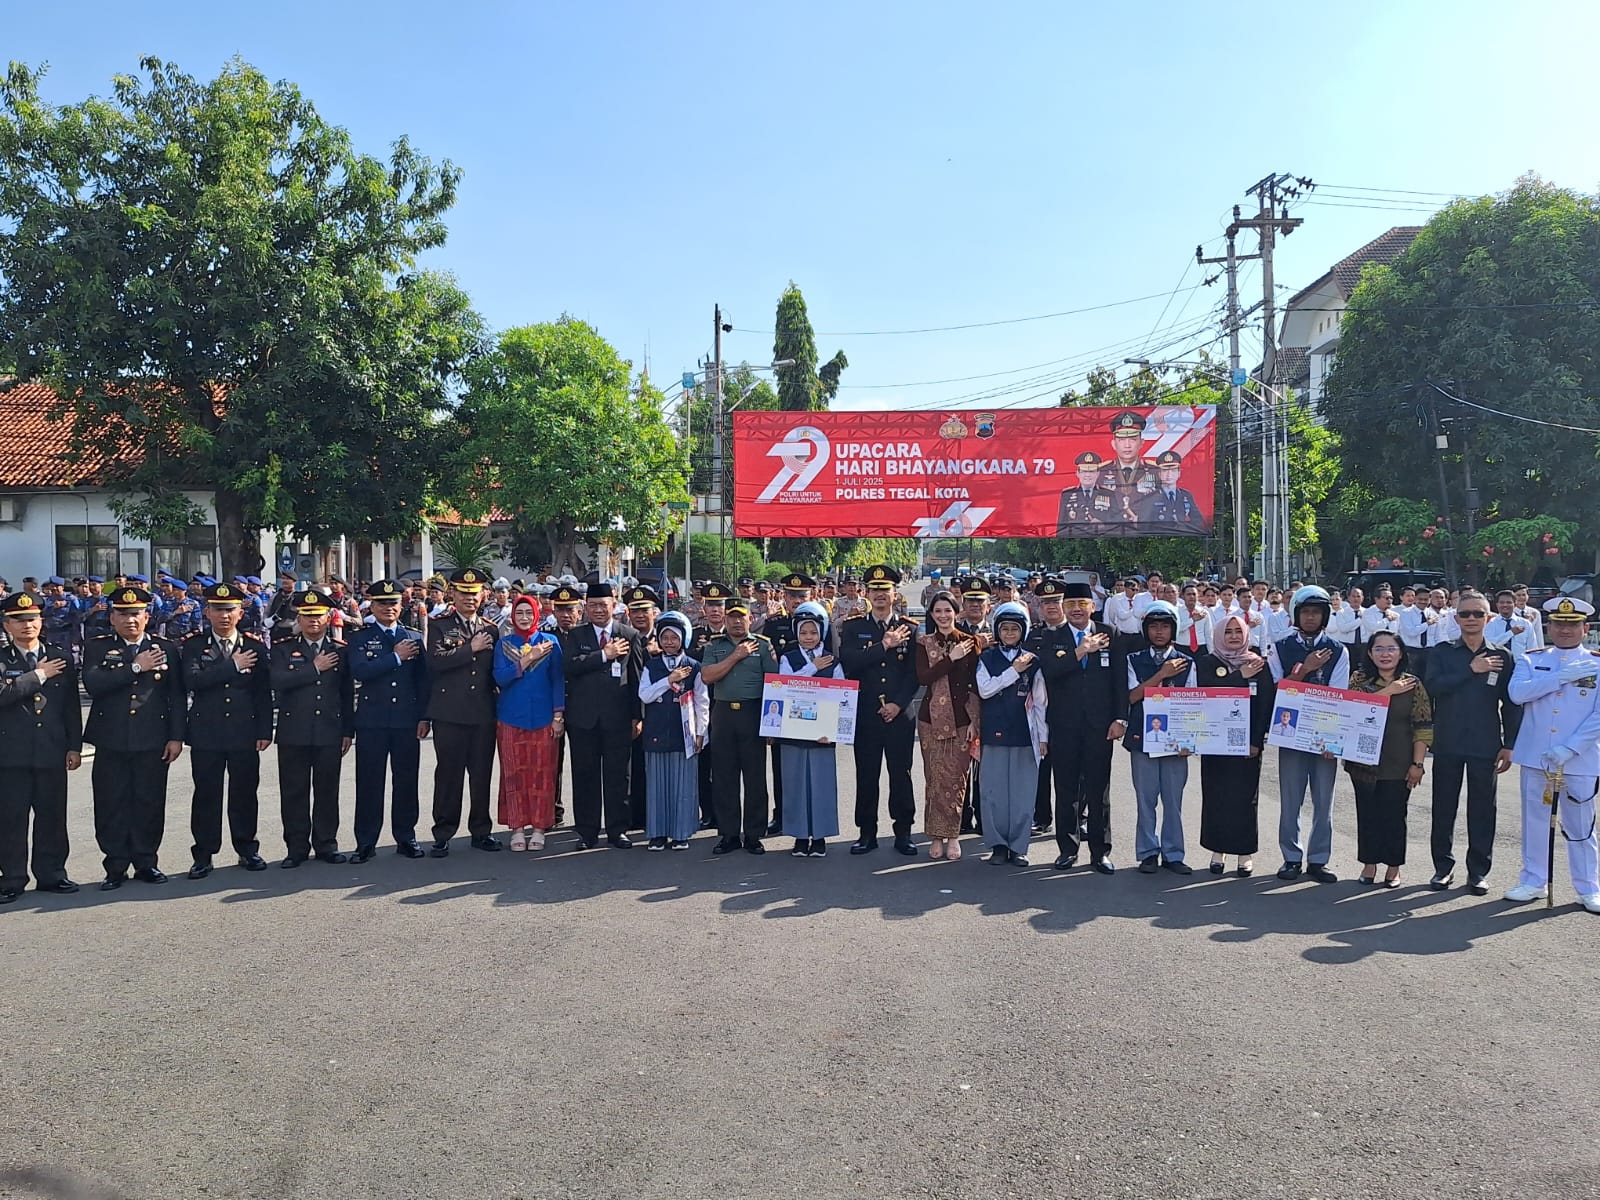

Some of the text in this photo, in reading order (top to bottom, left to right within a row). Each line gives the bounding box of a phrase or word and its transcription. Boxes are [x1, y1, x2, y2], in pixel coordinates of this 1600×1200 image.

[835, 443, 923, 459] UPACARA
[835, 458, 1056, 476] HARI BHAYANGKARA 79
[842, 478, 861, 486] JULI
[863, 477, 884, 486] 2025
[835, 487, 970, 500] POLRES TEGAL KOTA
[1305, 687, 1344, 699] INDONESIA
